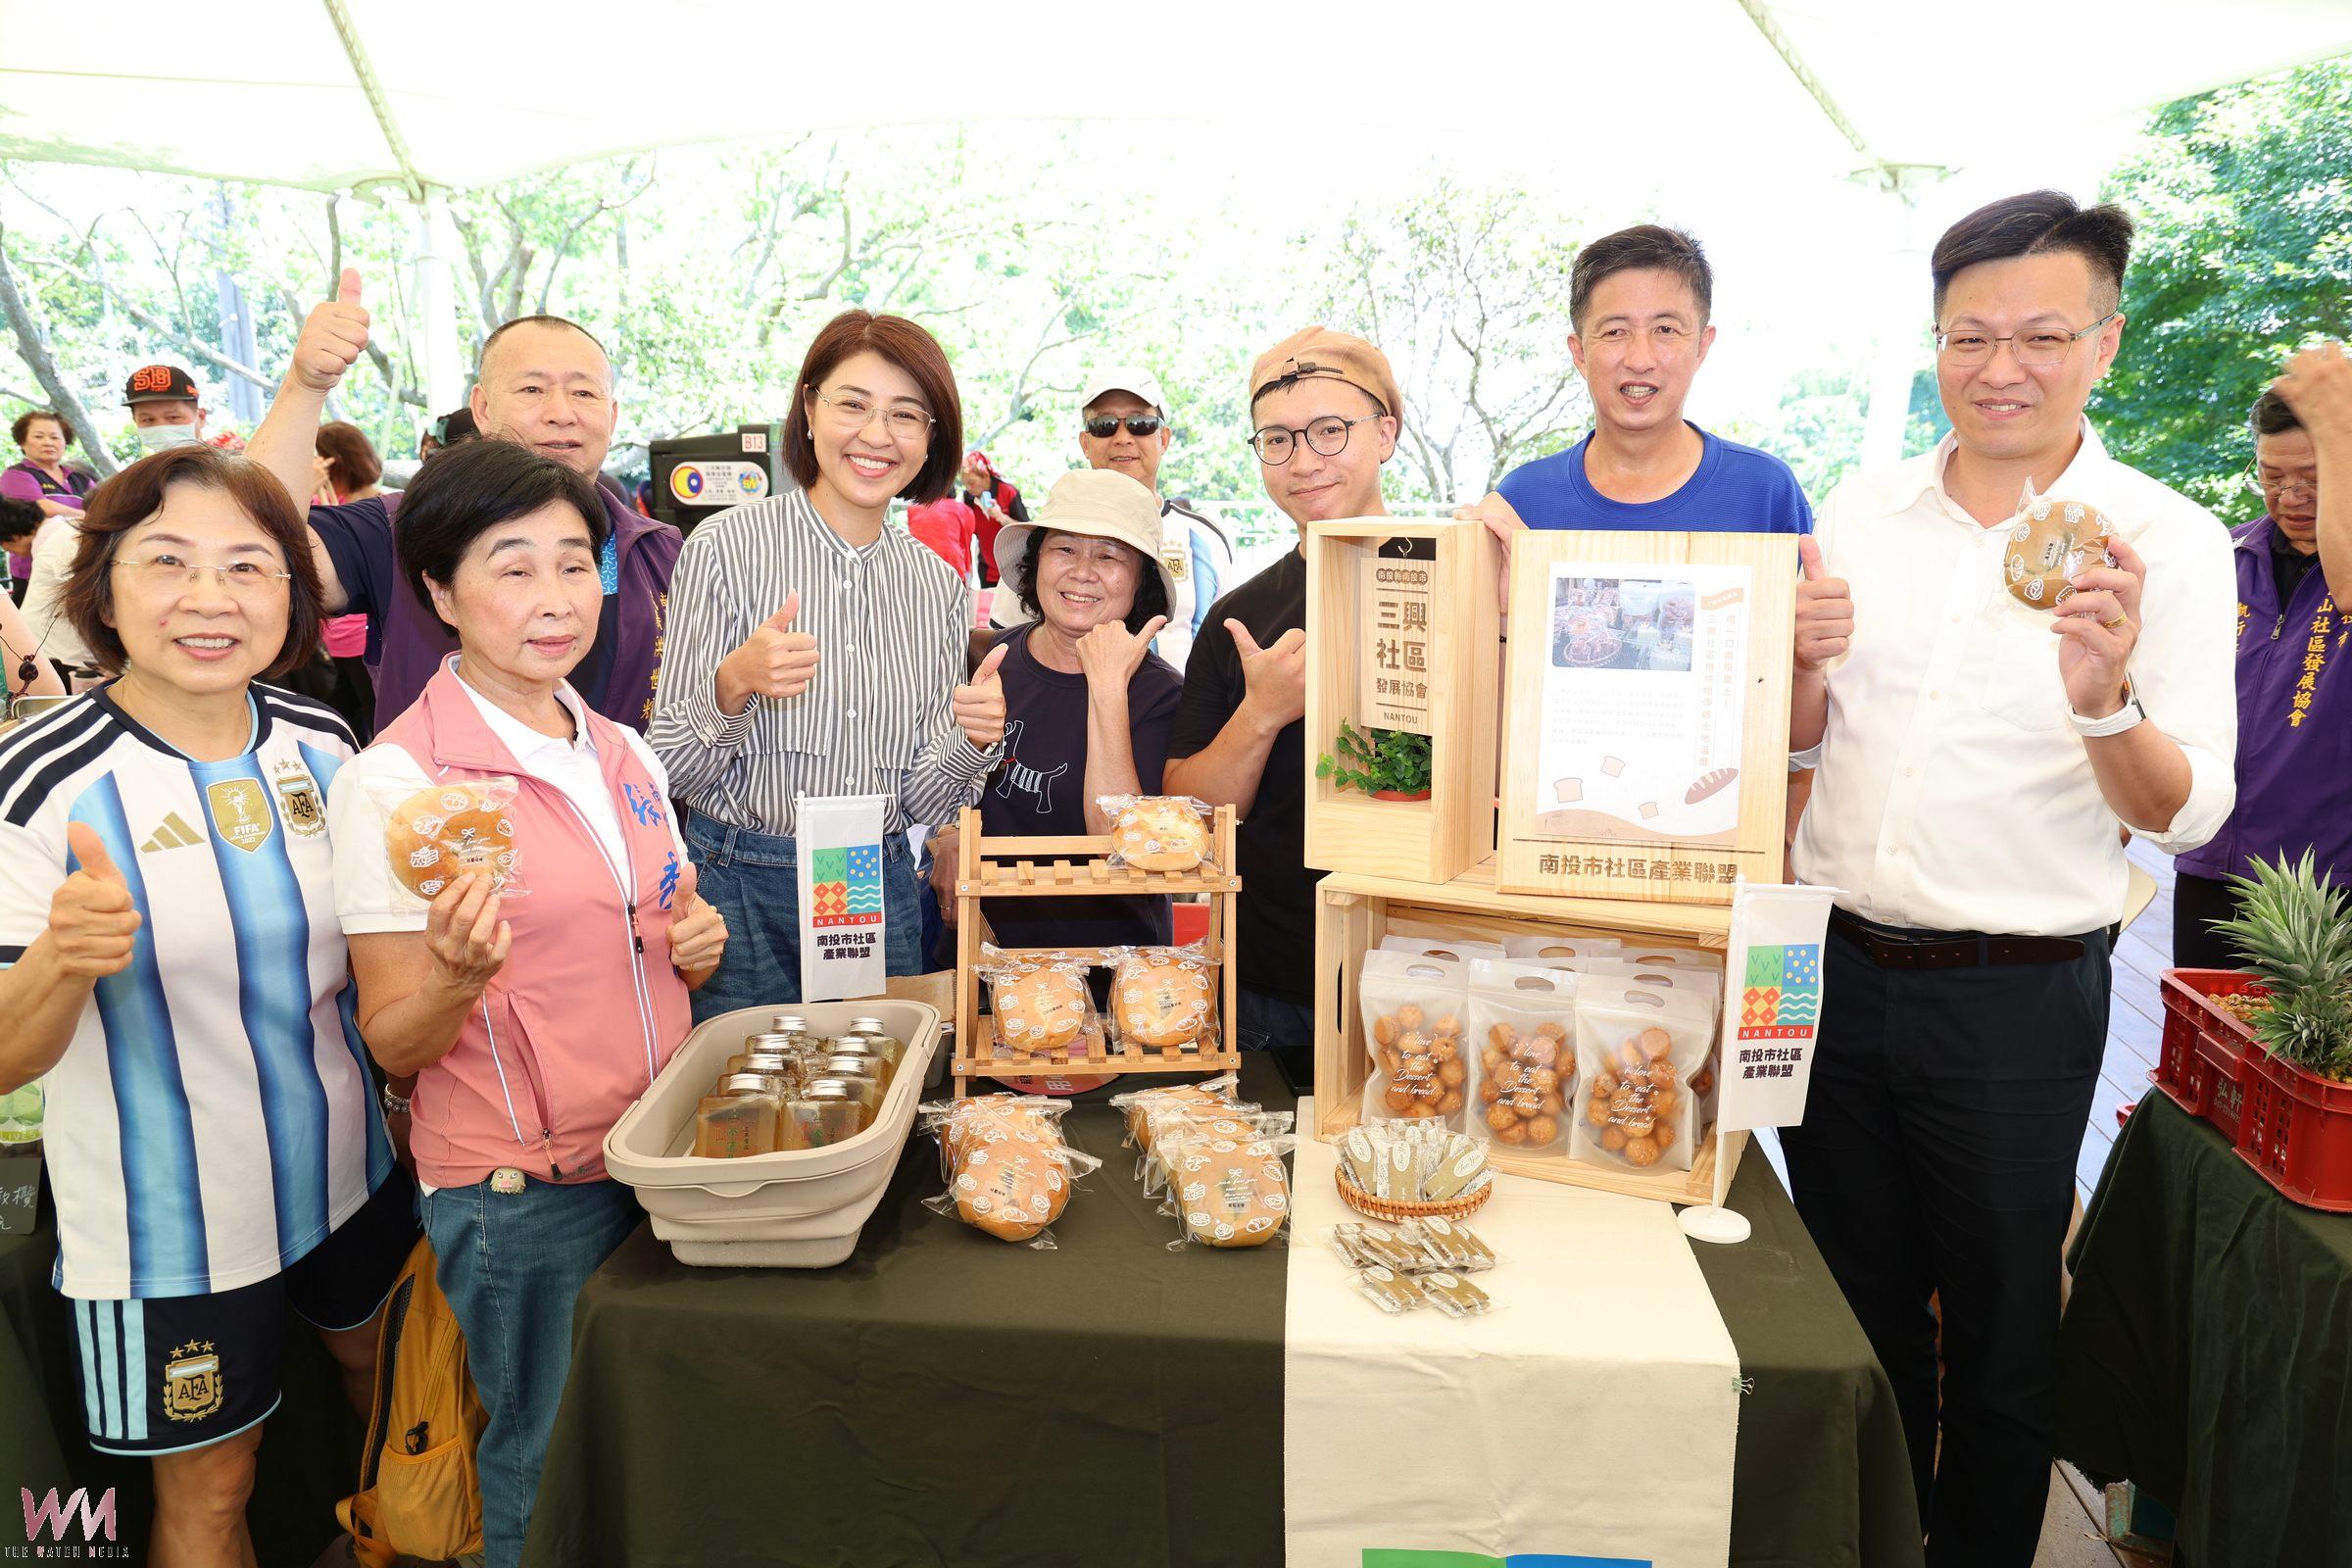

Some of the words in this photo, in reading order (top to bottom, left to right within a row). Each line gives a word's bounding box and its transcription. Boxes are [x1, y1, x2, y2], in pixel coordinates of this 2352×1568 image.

[745, 435, 763, 450] B13
[1377, 601, 1427, 633] 三興
[1376, 638, 1427, 672] 社區
[2287, 590, 2334, 727] 山社區發展協會
[1376, 677, 1428, 700] 發展協會
[1384, 711, 1418, 724] NANTOU
[293, 791, 314, 818] AFA
[234, 823, 260, 836] FIFA
[1540, 854, 1738, 884] 南投市社區產業聯盟
[816, 915, 877, 926] NANTOU
[816, 932, 876, 947] 南投市社區
[823, 947, 870, 960] 產業聯盟
[1415, 1031, 1438, 1046] love
[1742, 1029, 1807, 1038] NANTOU
[1401, 1050, 1412, 1059] to
[1416, 1051, 1435, 1061] eat
[1523, 1043, 1542, 1058] love
[1740, 1048, 1802, 1063] 南投市社區
[1410, 1060, 1424, 1072] the
[1509, 1060, 1520, 1072] to
[1524, 1063, 1544, 1074] eat
[1634, 1061, 1656, 1077] love
[1742, 1064, 1793, 1079] 產業聯盟
[1394, 1068, 1437, 1082] Dessert
[1518, 1073, 1533, 1084] the
[1391, 1084, 1410, 1094] and
[1410, 1084, 1438, 1096] bread
[1500, 1080, 1543, 1095] Dessert
[1620, 1080, 1632, 1091] to
[1635, 1083, 1655, 1094] eat
[1496, 1097, 1517, 1106] and
[1517, 1097, 1545, 1109] bread
[1628, 1092, 1644, 1103] the
[1610, 1099, 1656, 1114] Dessert
[1607, 1116, 1628, 1126] and
[1628, 1116, 1656, 1129] bread
[178, 1374, 209, 1400] AFA
